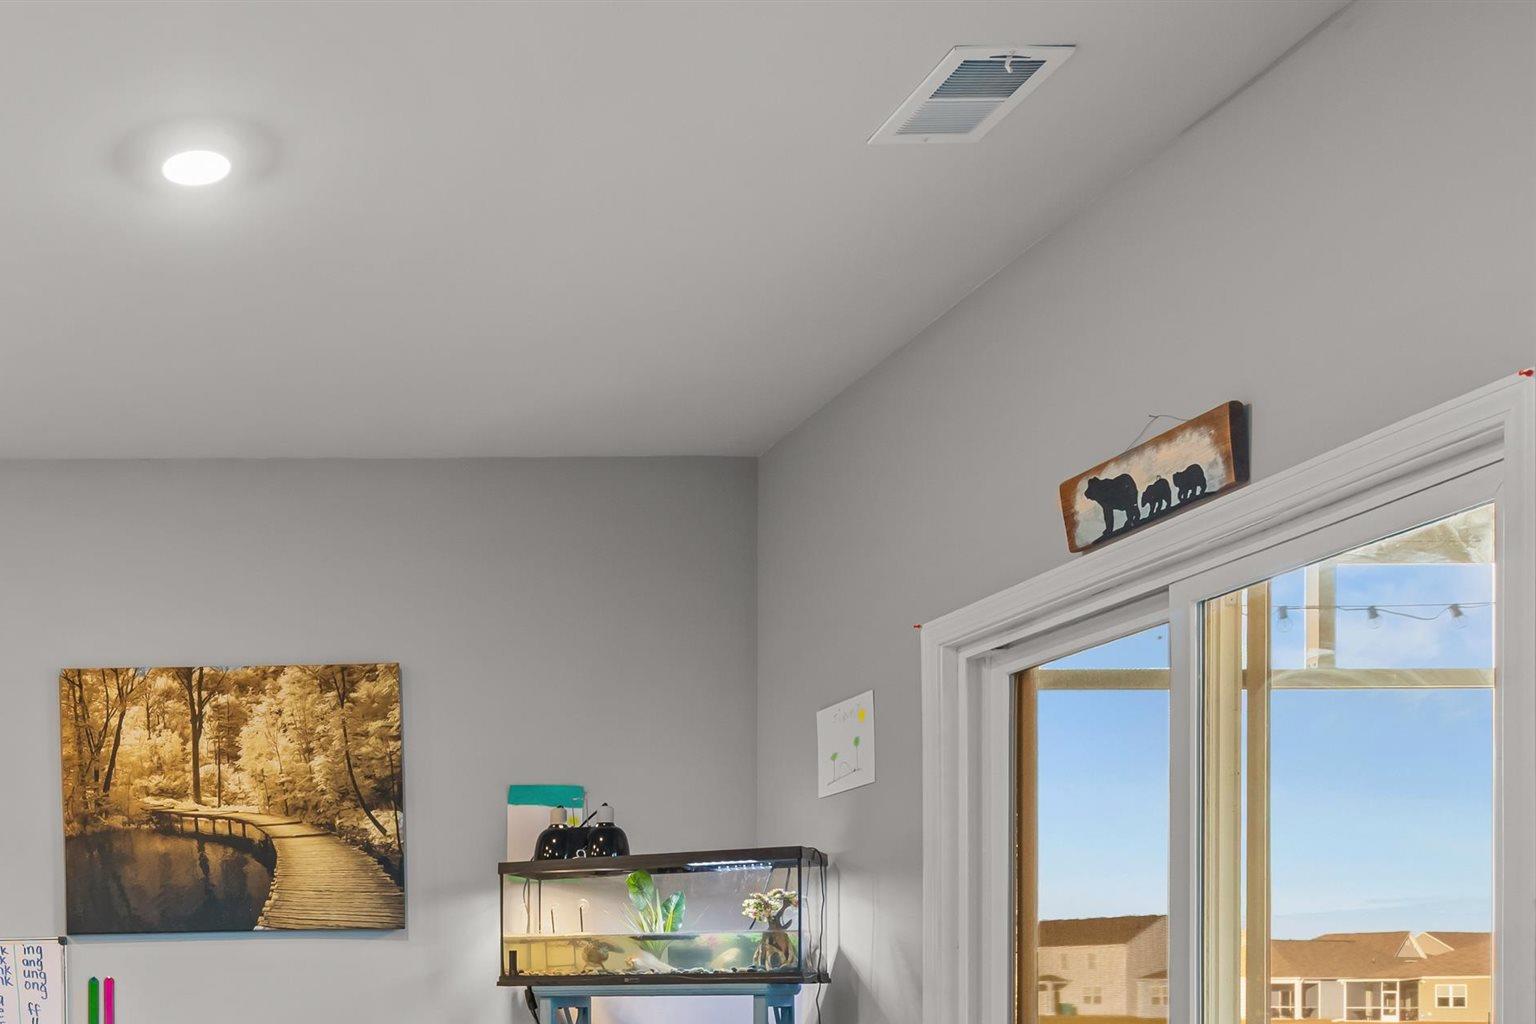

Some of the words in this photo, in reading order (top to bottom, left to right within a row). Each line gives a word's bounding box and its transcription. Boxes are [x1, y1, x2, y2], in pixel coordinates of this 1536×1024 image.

[22, 944, 44, 960] ing
[21, 958, 44, 972] ang
[23, 969, 48, 986] ung
[24, 980, 48, 1000] ong
